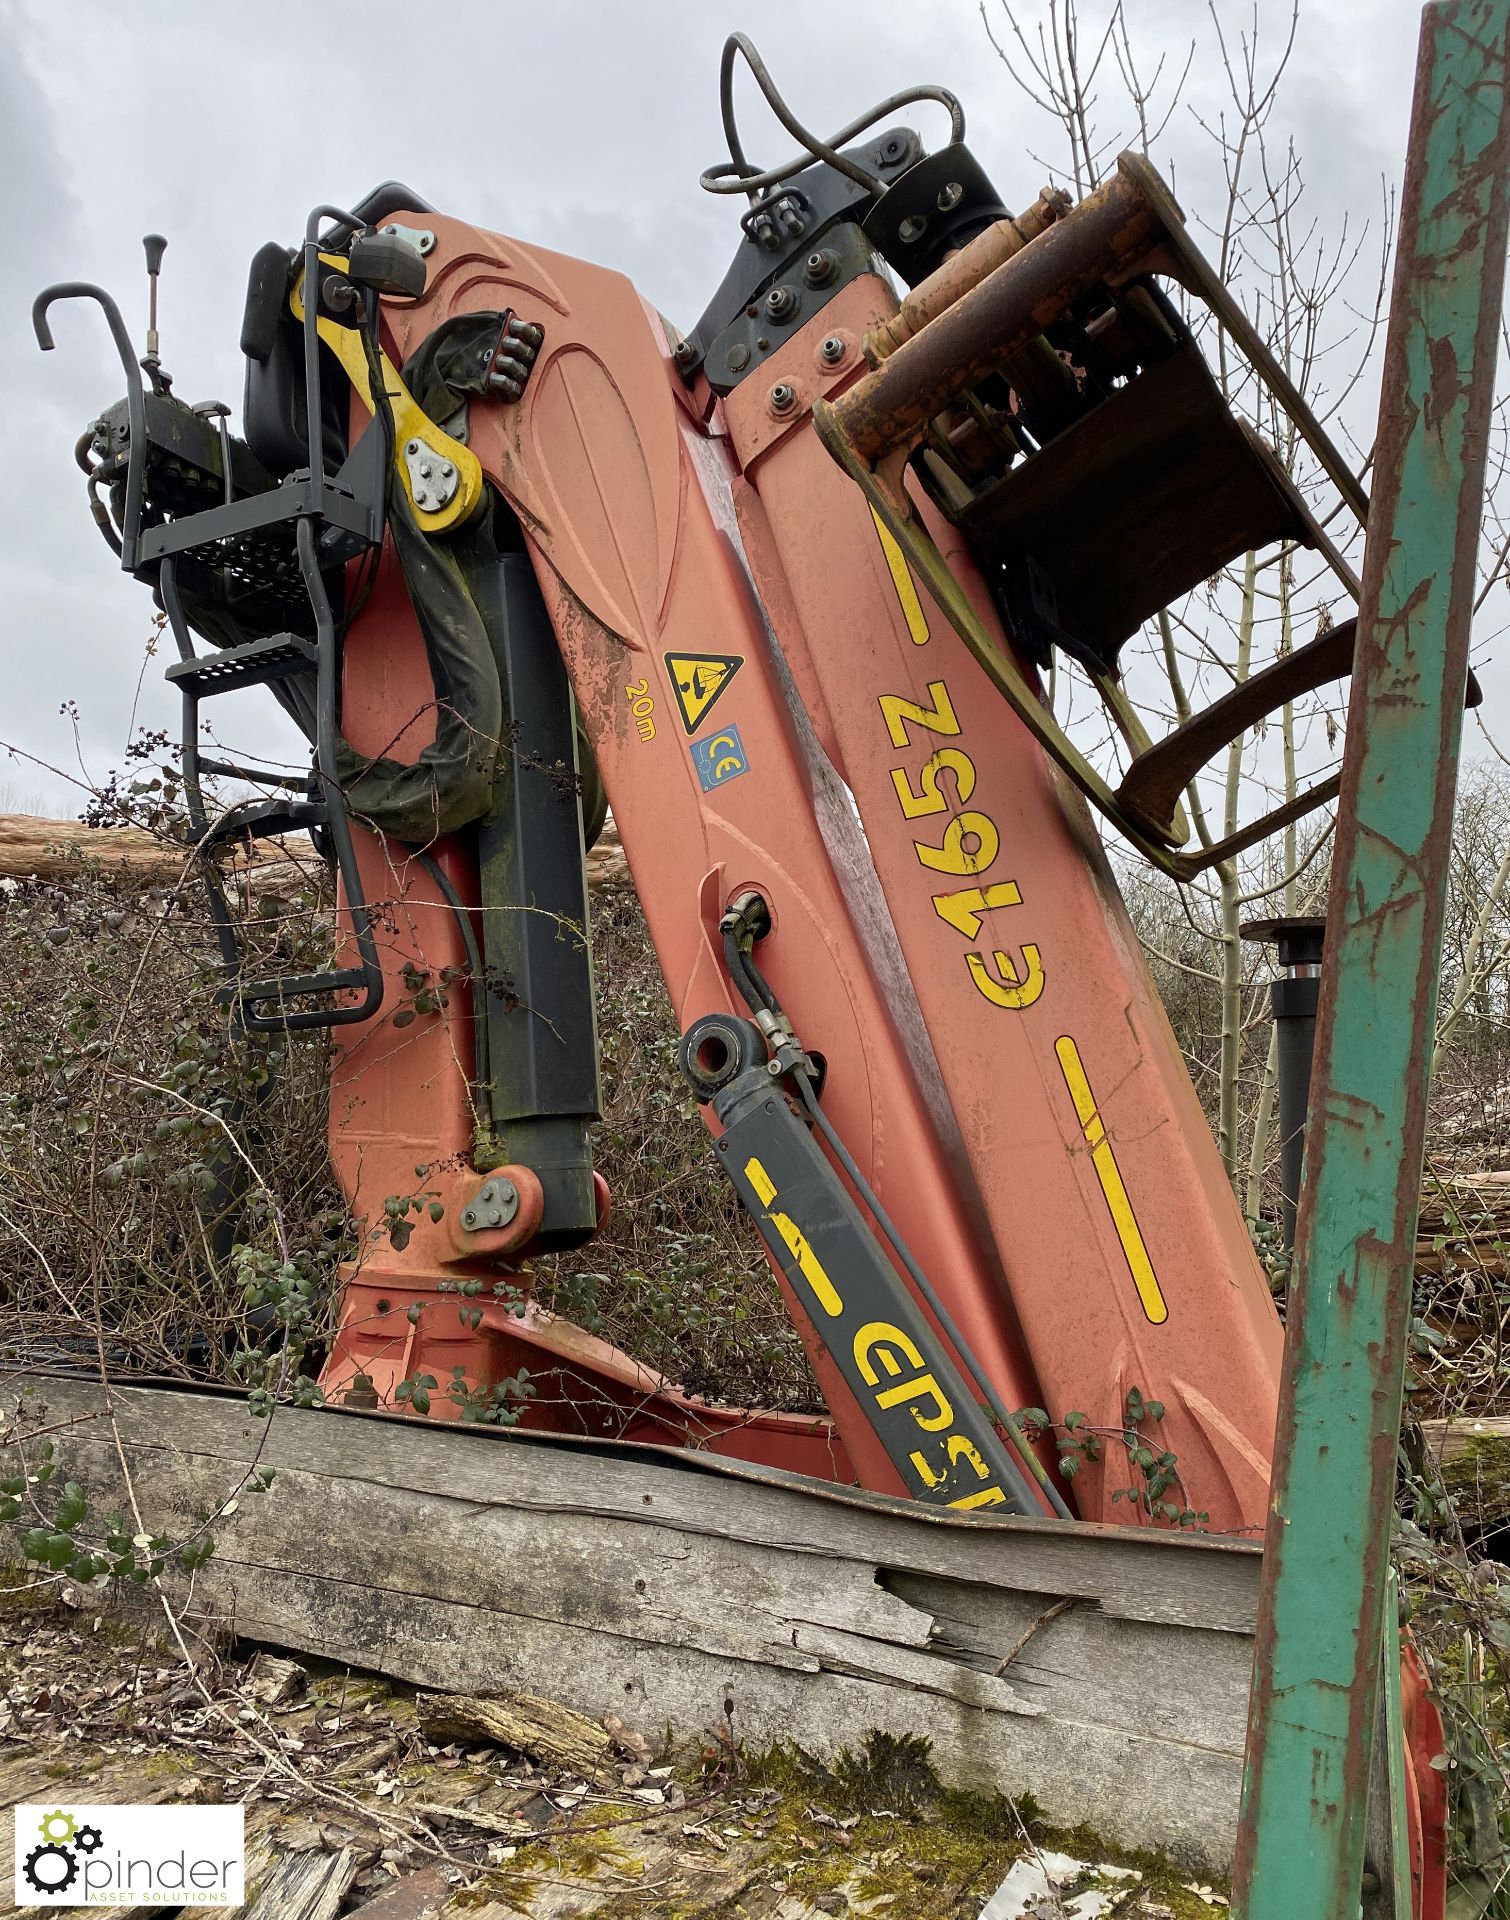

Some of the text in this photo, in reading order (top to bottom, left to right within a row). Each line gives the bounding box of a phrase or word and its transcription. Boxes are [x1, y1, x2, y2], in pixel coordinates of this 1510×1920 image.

[625, 679, 656, 743] 20m
[709, 736, 741, 779] CE
[878, 680, 1045, 1010] E165Z
